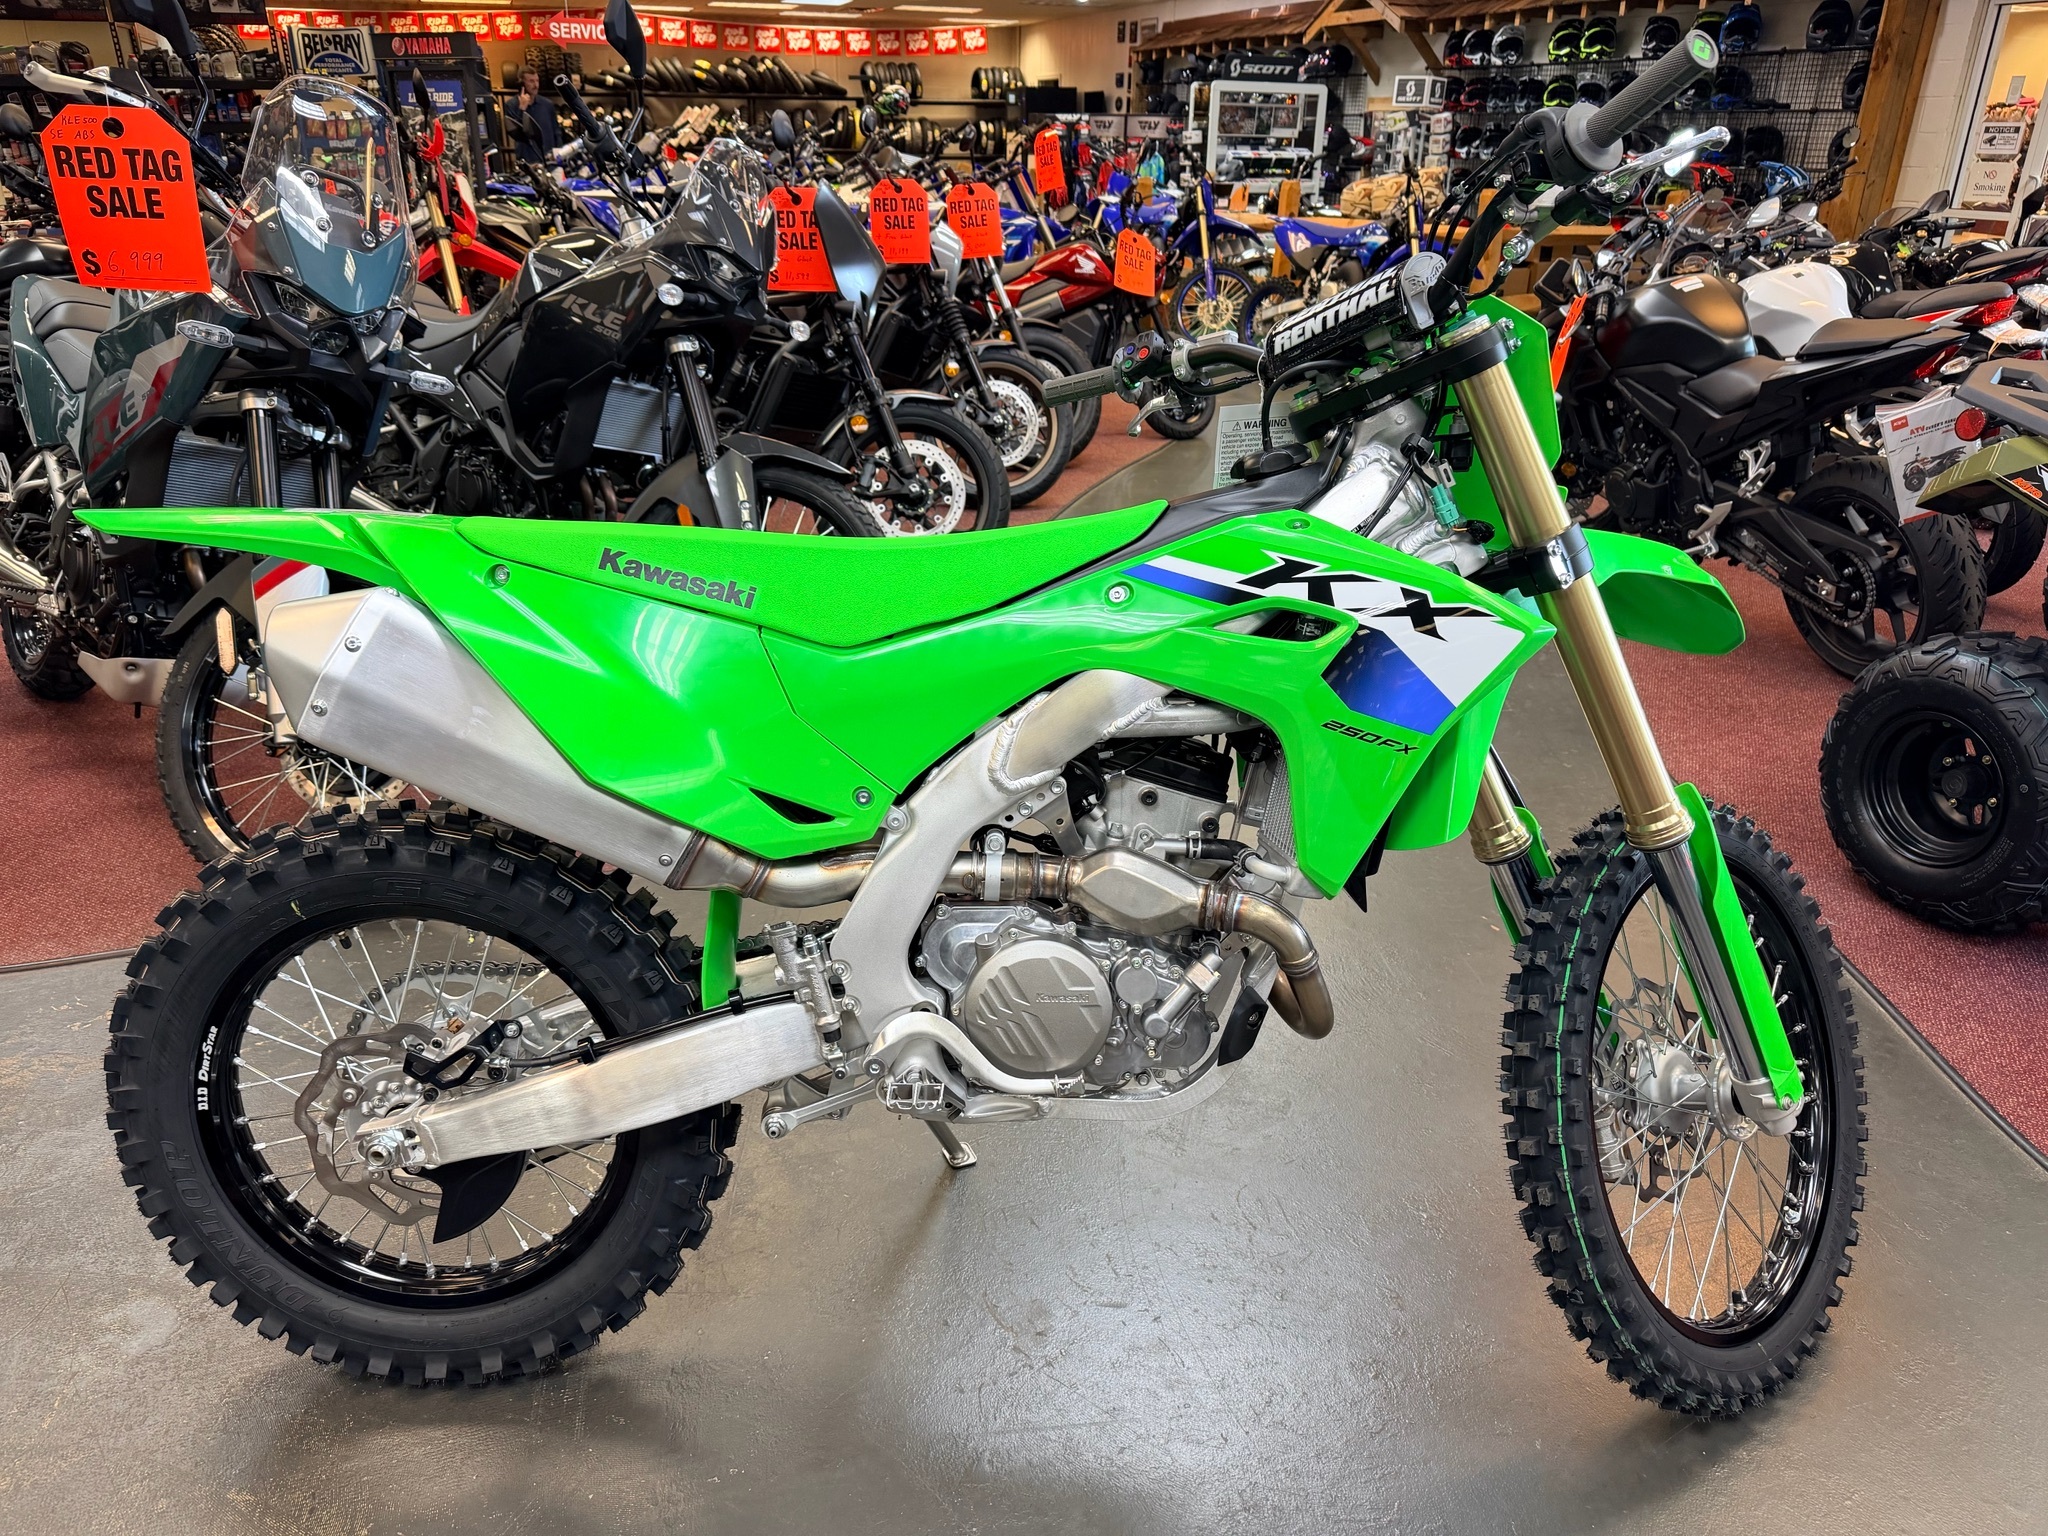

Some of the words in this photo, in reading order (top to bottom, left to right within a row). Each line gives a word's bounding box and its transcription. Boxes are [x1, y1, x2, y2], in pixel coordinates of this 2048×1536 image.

[277, 14, 300, 24] RIDE
[316, 15, 338, 25] RIDE
[354, 16, 375, 25] RIDE
[391, 16, 412, 26] RIDE
[426, 16, 447, 26] RIDE
[461, 15, 482, 26] RIDE
[495, 14, 517, 26] RIDE
[550, 21, 606, 40] SERVIC
[405, 36, 452, 55] YAMAHA
[1241, 64, 1294, 75] SCOTT
[433, 93, 454, 102] RIDE
[61, 115, 80, 125] KLE
[50, 129, 64, 139] SE
[74, 130, 95, 140] ABS
[1046, 141, 1058, 152] TAG
[52, 145, 117, 179] RED
[121, 148, 183, 182] TAG
[1040, 156, 1054, 168] SALE
[1973, 183, 2006, 193] Smoking
[86, 185, 165, 219] SALE
[873, 197, 898, 212] RED
[900, 197, 924, 212] TAG
[950, 200, 972, 214] RED
[973, 198, 995, 212] TAG
[777, 211, 797, 229] ED
[800, 211, 819, 229] TA
[884, 215, 916, 230] SALE
[960, 214, 987, 229] SALE
[779, 232, 818, 250] SALE
[1119, 240, 1134, 255] RED
[1136, 245, 1152, 261] TAG
[81, 249, 101, 277] $
[108, 251, 163, 276] 6,999
[1123, 256, 1144, 271] SALE
[769, 269, 780, 284] $
[561, 293, 627, 332] KLE
[1274, 279, 1396, 356] RENTHAL
[593, 324, 622, 340] 500
[1910, 425, 1925, 435] ATV
[598, 547, 757, 610] Kawasaki
[1236, 556, 1498, 643] KX
[1321, 720, 1420, 755] 250FX
[1036, 993, 1090, 1003] Kawasaki
[160, 1140, 323, 1313] DUNLOP
